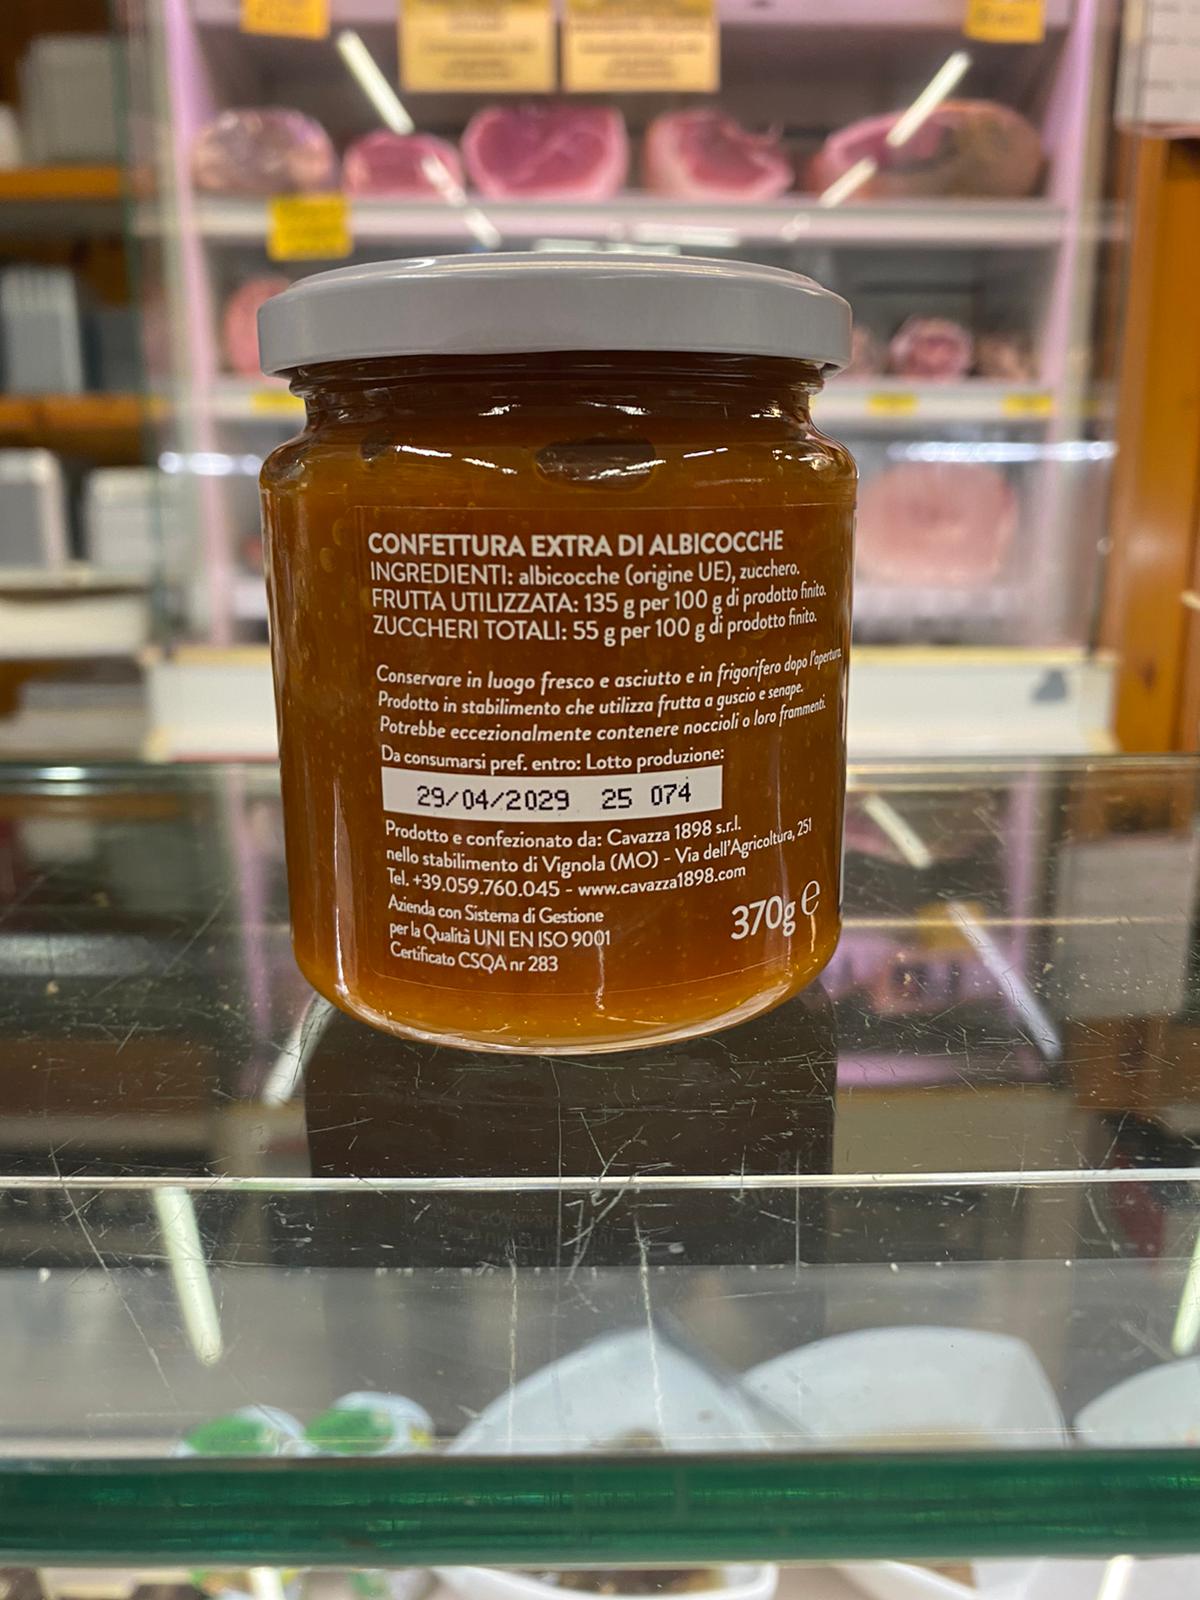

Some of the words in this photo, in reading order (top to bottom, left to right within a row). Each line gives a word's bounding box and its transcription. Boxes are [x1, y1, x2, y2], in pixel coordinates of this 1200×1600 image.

[368, 532, 526, 557] CONFETTURA
[531, 534, 613, 557] EXTRA
[618, 534, 644, 556] DI
[649, 529, 784, 555] ALBICOCCHE
[370, 561, 513, 585] INGREDIENTI:
[519, 564, 620, 585] albicocche
[625, 563, 694, 591] (origine
[698, 560, 735, 584] UE),
[740, 558, 800, 580] zucchero.
[372, 588, 446, 611] FRUTTA
[451, 591, 579, 613] UTILIZZATA:
[584, 592, 619, 613] 135
[623, 599, 635, 619] g
[640, 596, 670, 618] per
[674, 589, 708, 610] 100
[712, 594, 723, 615] g
[726, 587, 740, 607] di
[743, 584, 798, 612] prodotto
[800, 580, 827, 600] finito.
[372, 614, 478, 639] ZUCCHERI
[483, 619, 567, 640] TOTALI:
[573, 620, 599, 640] 55
[604, 627, 616, 647] g
[620, 624, 651, 646] per
[655, 617, 690, 637] 100
[695, 622, 705, 642] g
[709, 615, 723, 635] di
[727, 612, 786, 640] prodotto
[788, 606, 817, 625] finito.
[376, 664, 462, 688] Conservare
[466, 671, 482, 688] in
[487, 671, 535, 695] luogo
[540, 671, 594, 696] fresco
[600, 677, 609, 688] e
[614, 669, 681, 688] asciutto
[686, 671, 695, 684] e
[699, 665, 713, 683] in
[717, 659, 781, 687] frigorifero
[784, 655, 808, 675] dopo
[378, 691, 439, 712] Prodotto
[443, 696, 457, 713] in
[461, 698, 561, 715] stabilimento
[565, 698, 594, 715] che
[599, 697, 654, 714] utilizza
[657, 693, 700, 718] frutta
[704, 697, 713, 708] a
[716, 686, 756, 711] guscio
[758, 688, 766, 700] e
[768, 681, 804, 701] senape.
[380, 715, 446, 738] Potrebbe
[450, 724, 592, 741] eccezionalmente
[597, 724, 679, 741] contenere
[683, 712, 739, 734] noccioli
[742, 716, 750, 728] o
[753, 709, 777, 726] loro
[779, 694, 826, 727] frammenti.
[381, 744, 401, 762] Da
[404, 753, 486, 769] consumarsi
[490, 753, 528, 776] pref.
[532, 757, 581, 771] entro:
[586, 754, 632, 770] Lotto
[637, 747, 725, 774] produzione:
[416, 785, 570, 811] 29/04/2029
[601, 787, 633, 810] 25
[651, 782, 692, 806] 074
[386, 820, 449, 843] Prodotto
[452, 833, 462, 845] e
[466, 830, 573, 848] confezionato
[577, 831, 602, 847] da:
[607, 828, 670, 846] Cavazza
[674, 820, 712, 840] 1898
[715, 814, 741, 834] s.r.l.
[386, 846, 419, 864] nello
[422, 852, 519, 871] stabilimento
[522, 855, 538, 872] di
[542, 855, 605, 879] Vignola
[610, 850, 659, 872] (MO)
[675, 847, 699, 864] Via
[703, 828, 795, 859] dell'Agricoltura,
[797, 817, 812, 837] 251
[387, 867, 410, 887] Tel.
[412, 873, 560, 897] +39.059.760.045
[578, 865, 746, 896] www.cavazza1898.com
[388, 894, 435, 916] Azienda
[437, 906, 462, 920] con
[464, 904, 519, 924] Sistema
[523, 907, 536, 923] di
[539, 907, 604, 924] Gestione
[730, 895, 796, 940] 370g
[389, 922, 409, 938] per
[411, 921, 421, 938] la
[423, 923, 471, 945] Qualità
[474, 930, 505, 947] UNI
[509, 930, 534, 947] EN
[538, 930, 568, 948] ISO
[571, 929, 611, 947] 9001
[390, 941, 455, 968] Certificato
[458, 952, 507, 974] CSQA
[510, 958, 525, 971] nr
[528, 956, 559, 972] 283
